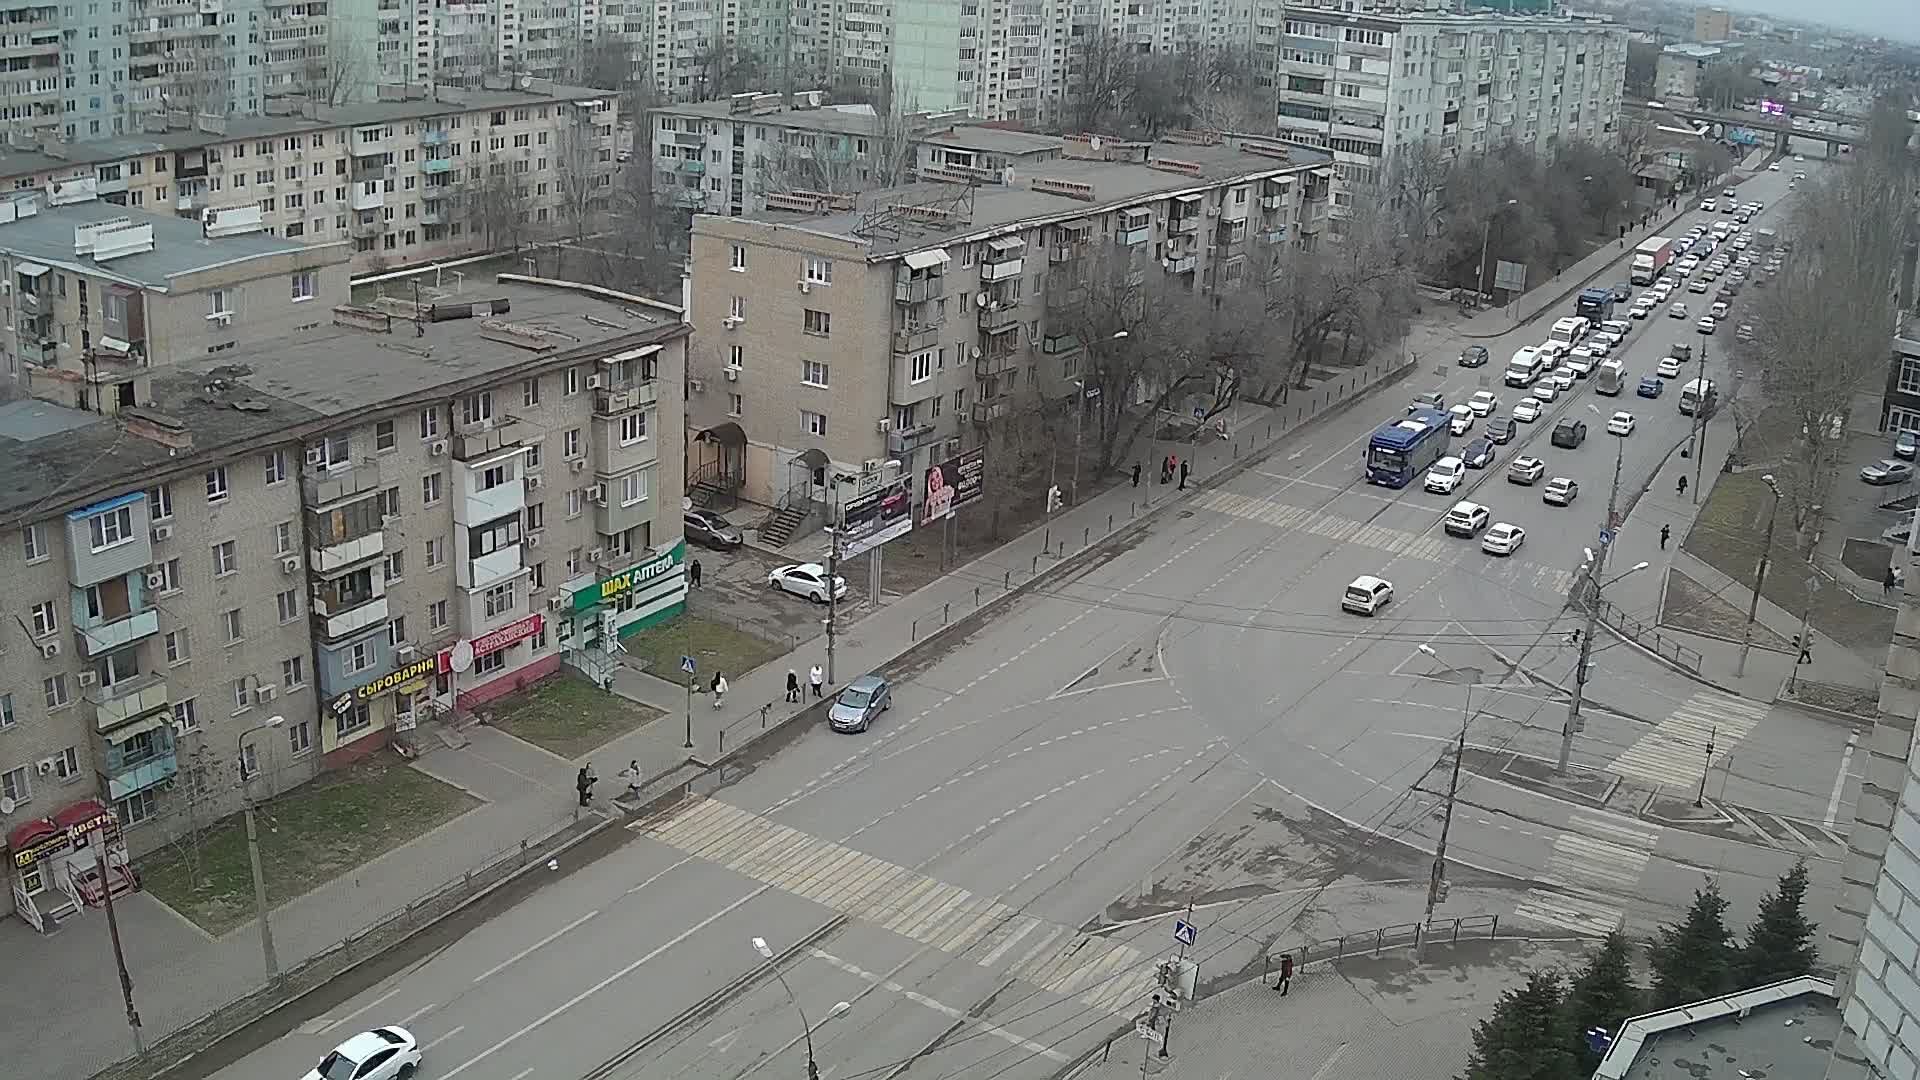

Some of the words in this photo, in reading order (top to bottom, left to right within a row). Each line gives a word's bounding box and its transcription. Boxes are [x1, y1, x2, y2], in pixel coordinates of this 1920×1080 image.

[602, 573, 631, 597] ШАХ
[633, 554, 674, 583] АПТЕКА
[358, 658, 434, 698] СЫРОВАРНЯ
